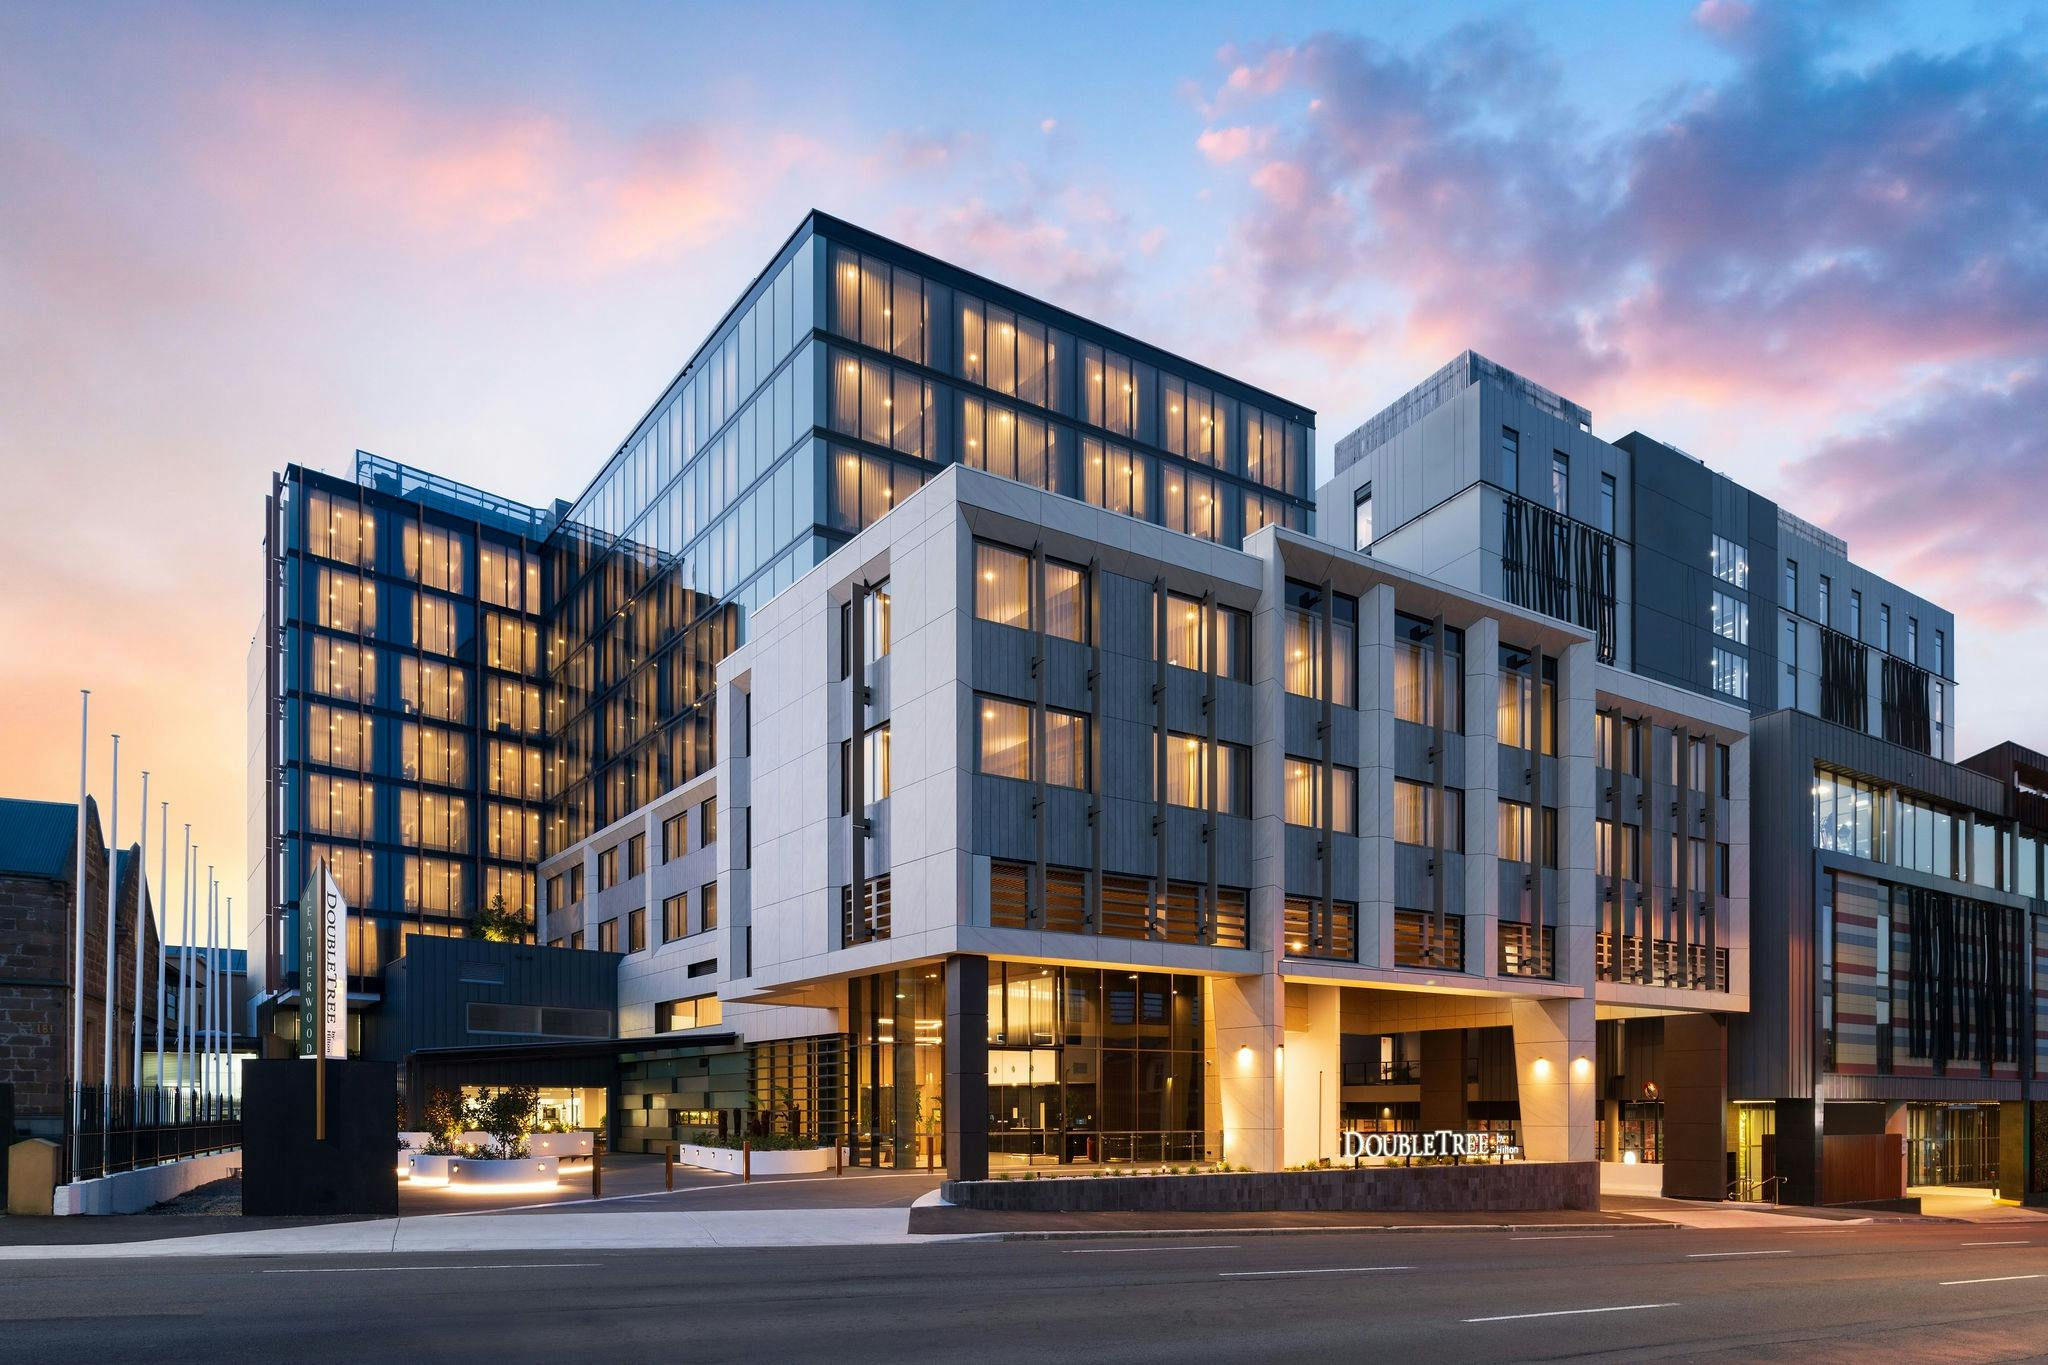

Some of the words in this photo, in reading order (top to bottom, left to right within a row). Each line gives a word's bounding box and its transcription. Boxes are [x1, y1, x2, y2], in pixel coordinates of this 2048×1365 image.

[305, 891, 313, 1054] LEATHERWOOD
[327, 891, 337, 1024] DOUBLETREE
[1343, 1130, 1490, 1158] DOUBLETREE
[1496, 1144, 1519, 1155] Hilton
